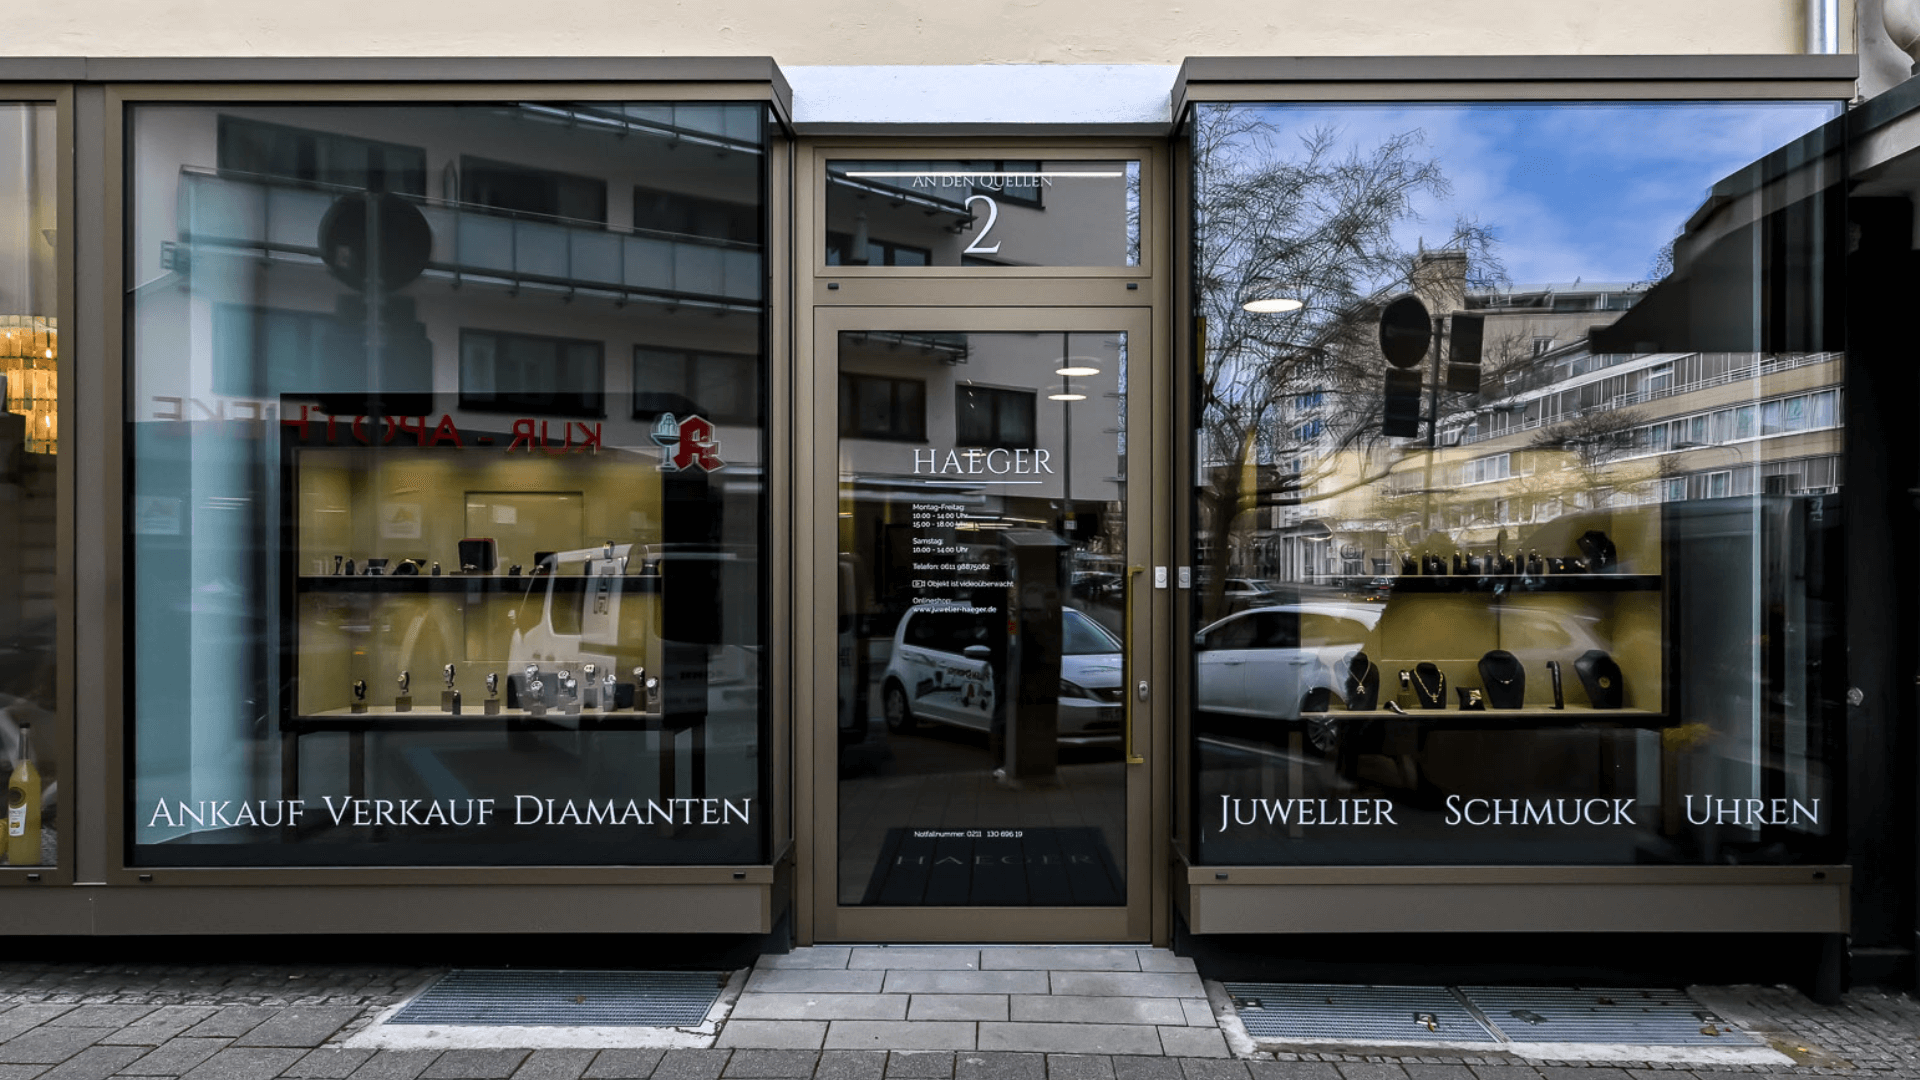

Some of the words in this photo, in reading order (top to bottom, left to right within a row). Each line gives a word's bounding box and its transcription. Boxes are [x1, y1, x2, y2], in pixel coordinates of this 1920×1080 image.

[912, 175, 937, 188] AN
[942, 175, 975, 188] DEN
[979, 175, 1053, 191] QUELLEN
[963, 194, 1002, 254] 2
[912, 448, 1055, 475] HAEGER
[955, 546, 969, 554] Uhr
[927, 580, 950, 588] Objekt
[950, 580, 959, 588] ist
[913, 605, 997, 614] www.juwelier-haeger.de
[148, 795, 305, 829] ANKAUF
[320, 795, 496, 828] VERKAUF
[513, 794, 753, 827] DIAMANTEN
[1218, 793, 1399, 832] JUWELIER
[1445, 793, 1637, 827] SCHMUCK
[1684, 793, 1821, 826] UHREN
[986, 830, 999, 838] 130
[1015, 830, 1023, 838] 19
